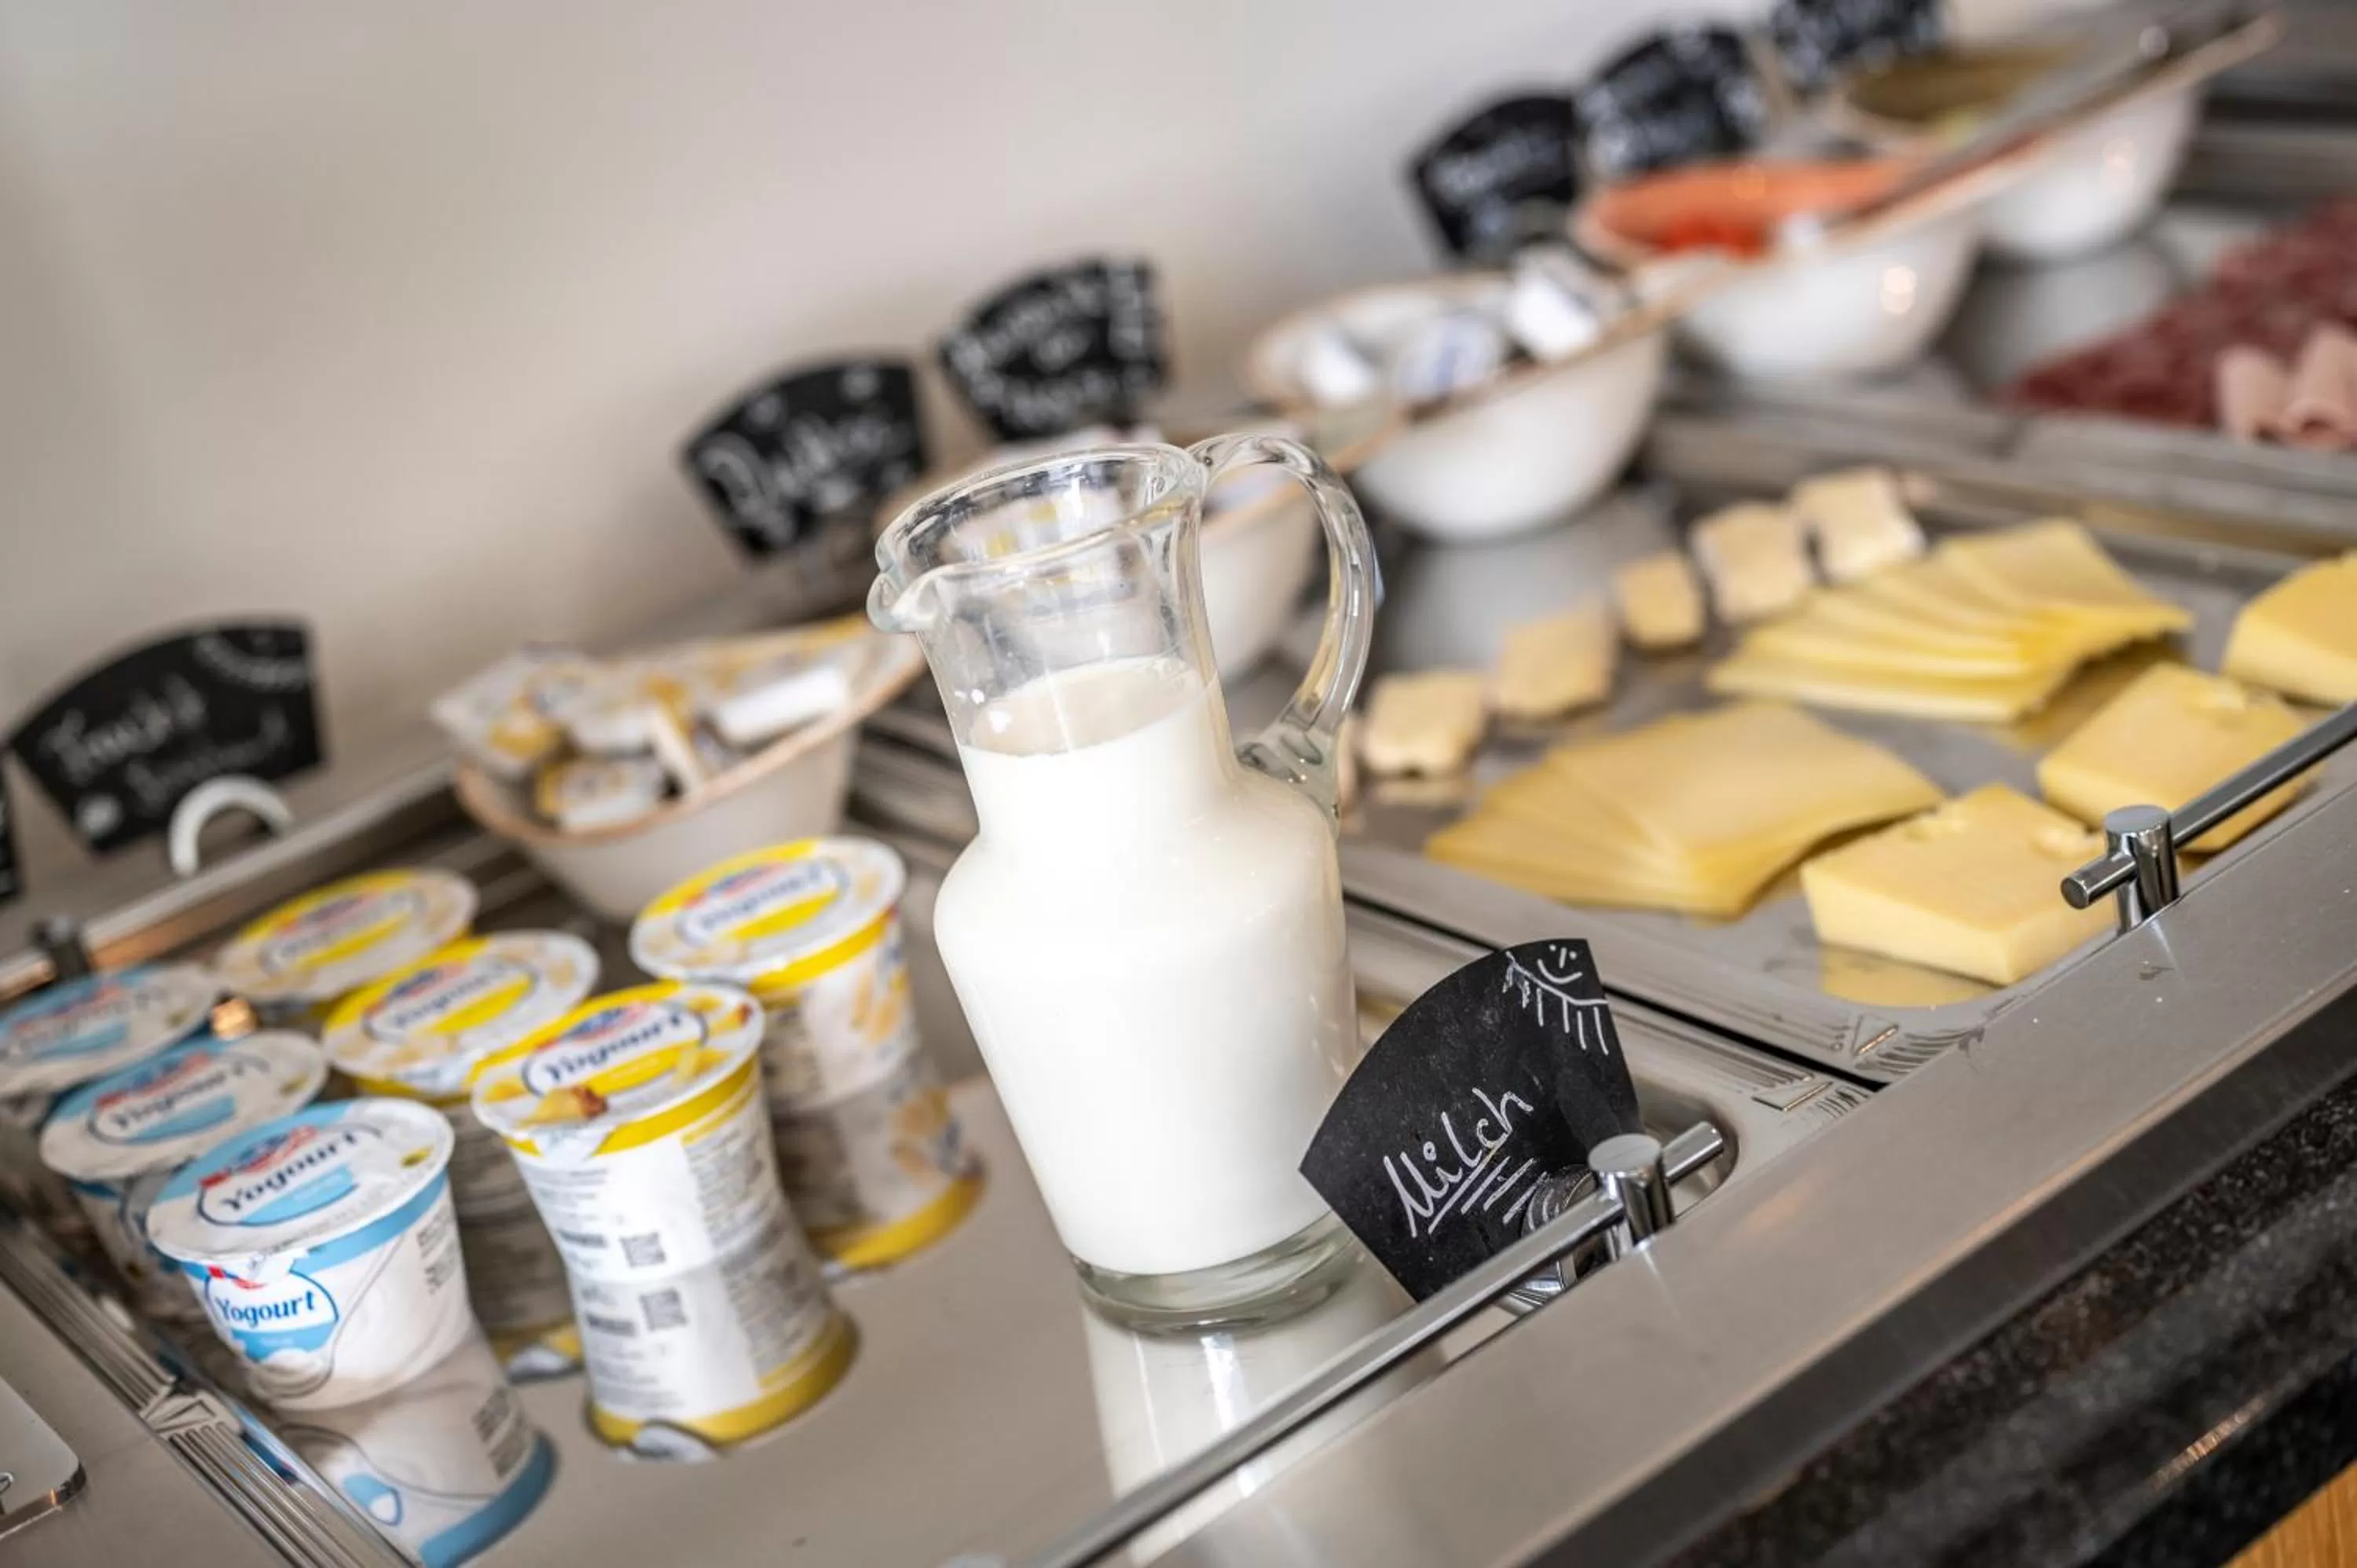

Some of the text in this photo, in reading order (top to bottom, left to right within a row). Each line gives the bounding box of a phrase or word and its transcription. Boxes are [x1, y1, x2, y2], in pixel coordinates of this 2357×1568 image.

[544, 1012, 682, 1083] Yogourt
[220, 1131, 357, 1210] Yogourt
[1384, 1086, 1534, 1238] Milch
[215, 1290, 315, 1328] Yogourt
